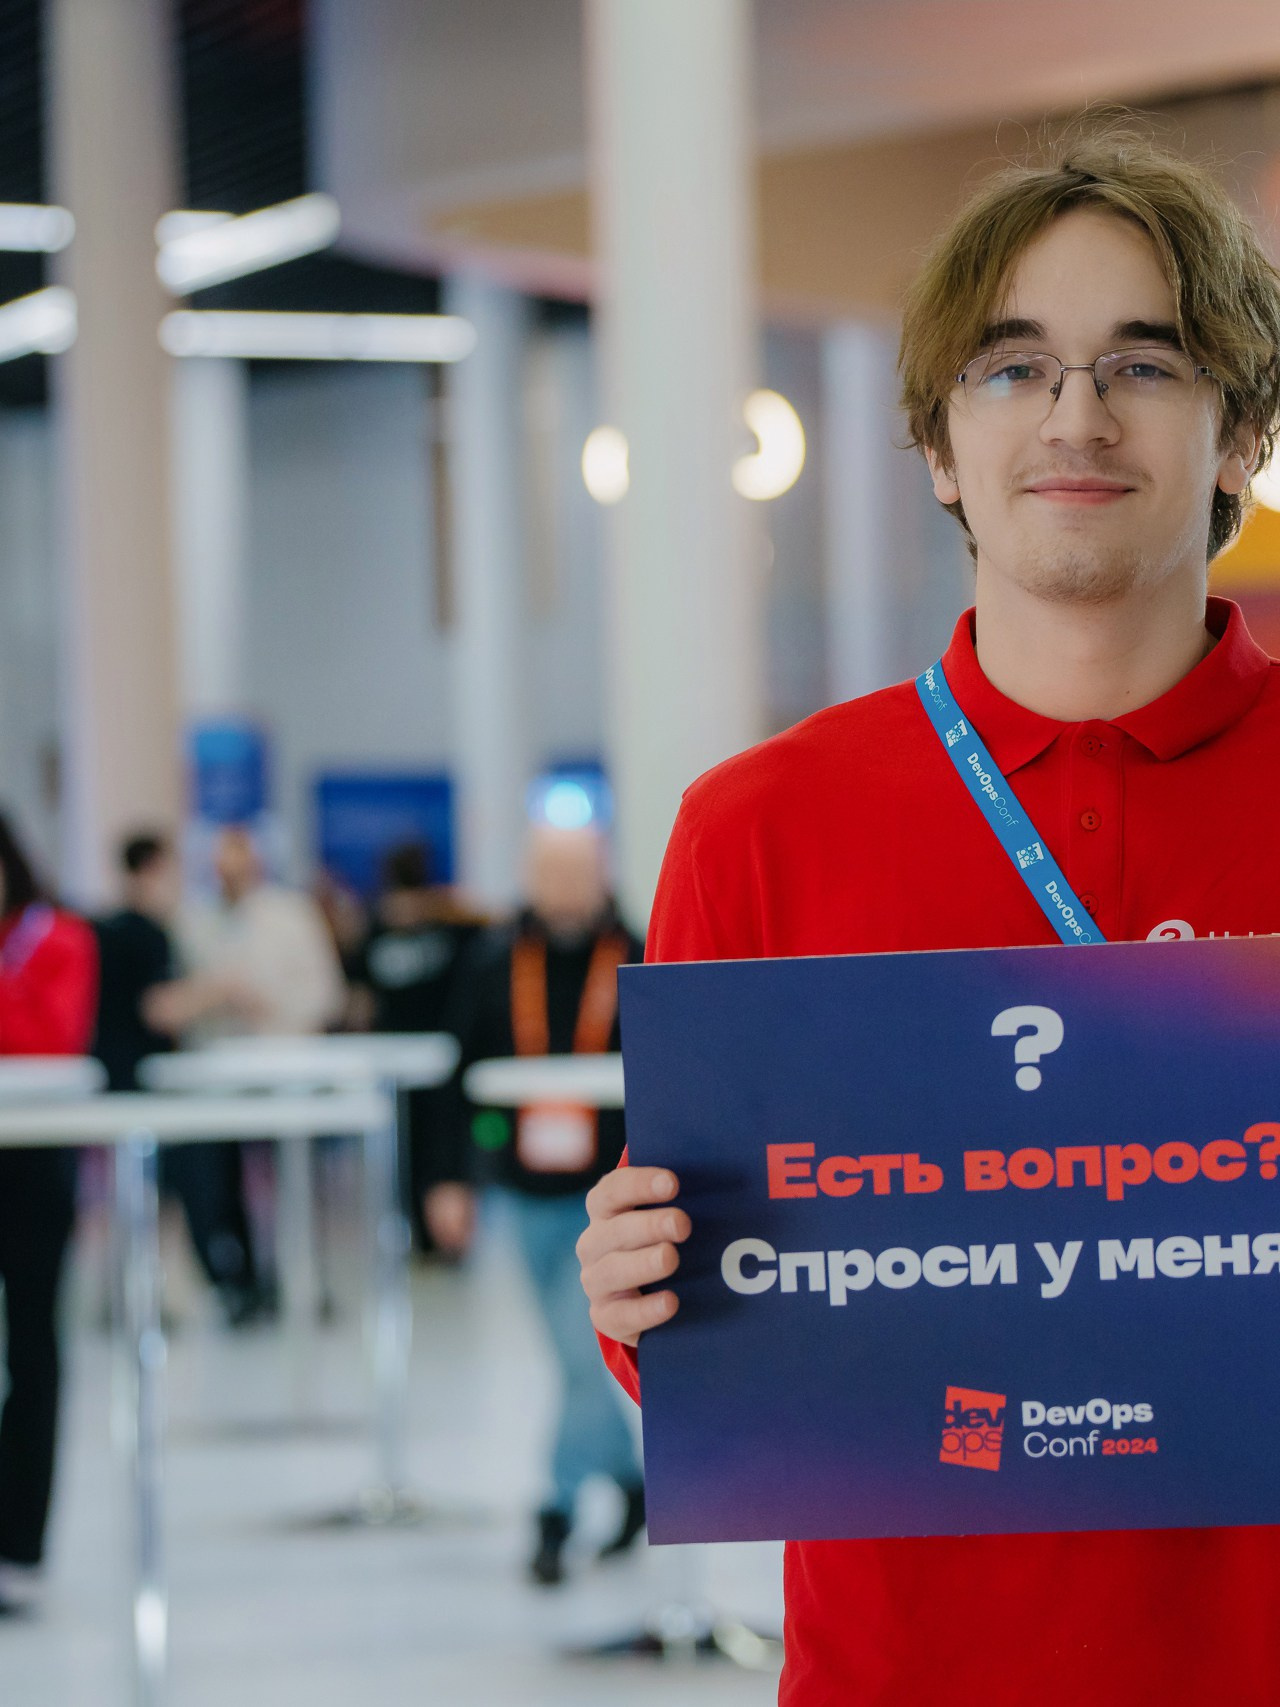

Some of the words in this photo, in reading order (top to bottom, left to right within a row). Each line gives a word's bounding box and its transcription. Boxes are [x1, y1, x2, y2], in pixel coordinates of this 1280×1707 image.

[991, 1005, 1065, 1091] ?
[767, 1142, 944, 1200] Есть
[721, 1237, 1018, 1306] Спроси
[1033, 1240, 1084, 1299] у
[1021, 1398, 1154, 1430] DevOps
[942, 1432, 1003, 1461] ops
[1023, 1429, 1100, 1458] Conf
[1101, 1437, 1159, 1456] 2024
